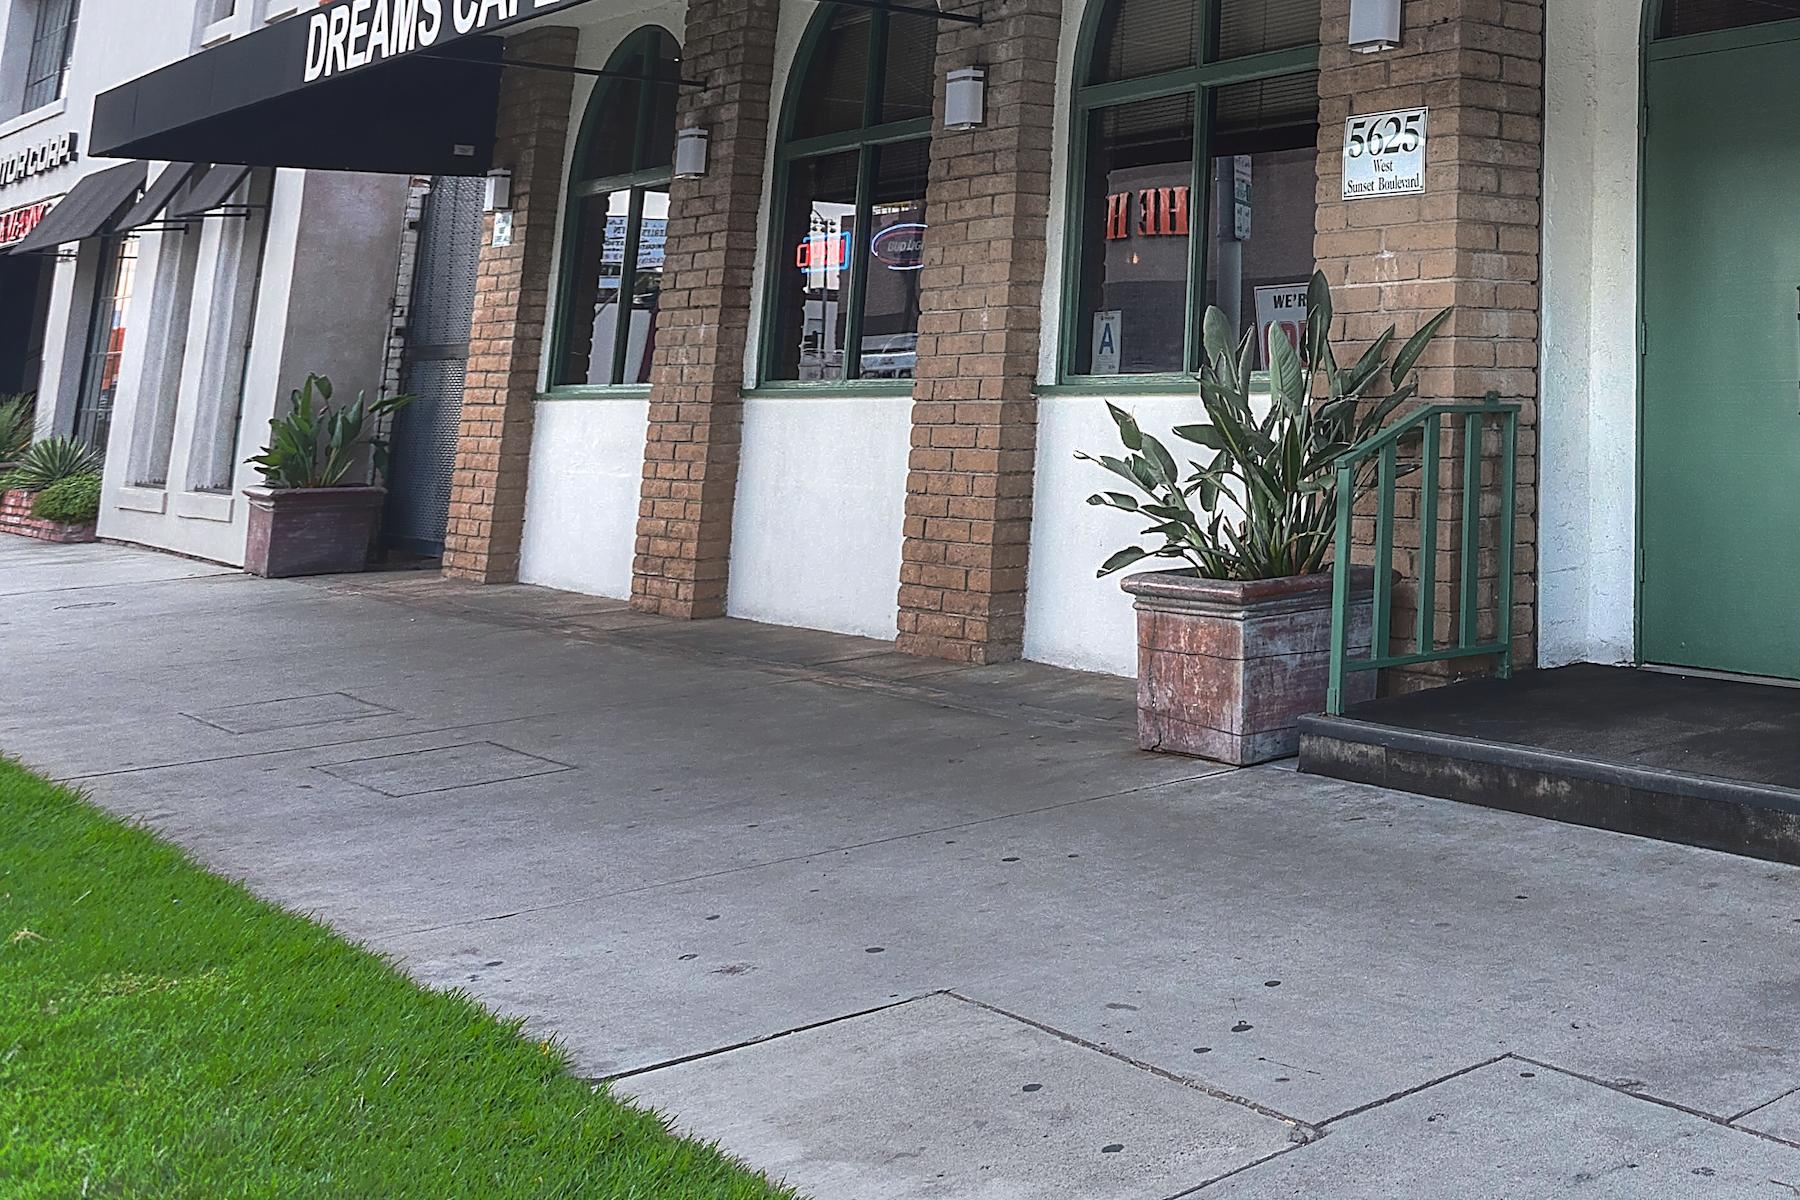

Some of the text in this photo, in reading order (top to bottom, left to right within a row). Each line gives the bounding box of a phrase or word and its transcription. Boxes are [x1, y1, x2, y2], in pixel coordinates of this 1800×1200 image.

[1348, 113, 1421, 158] 5625
[1373, 159, 1393, 173] West
[1347, 173, 1420, 194] Sunset Boulevard
[906, 239, 924, 252] LIG
[1273, 292, 1307, 308] WE'R
[1098, 322, 1115, 355] A
